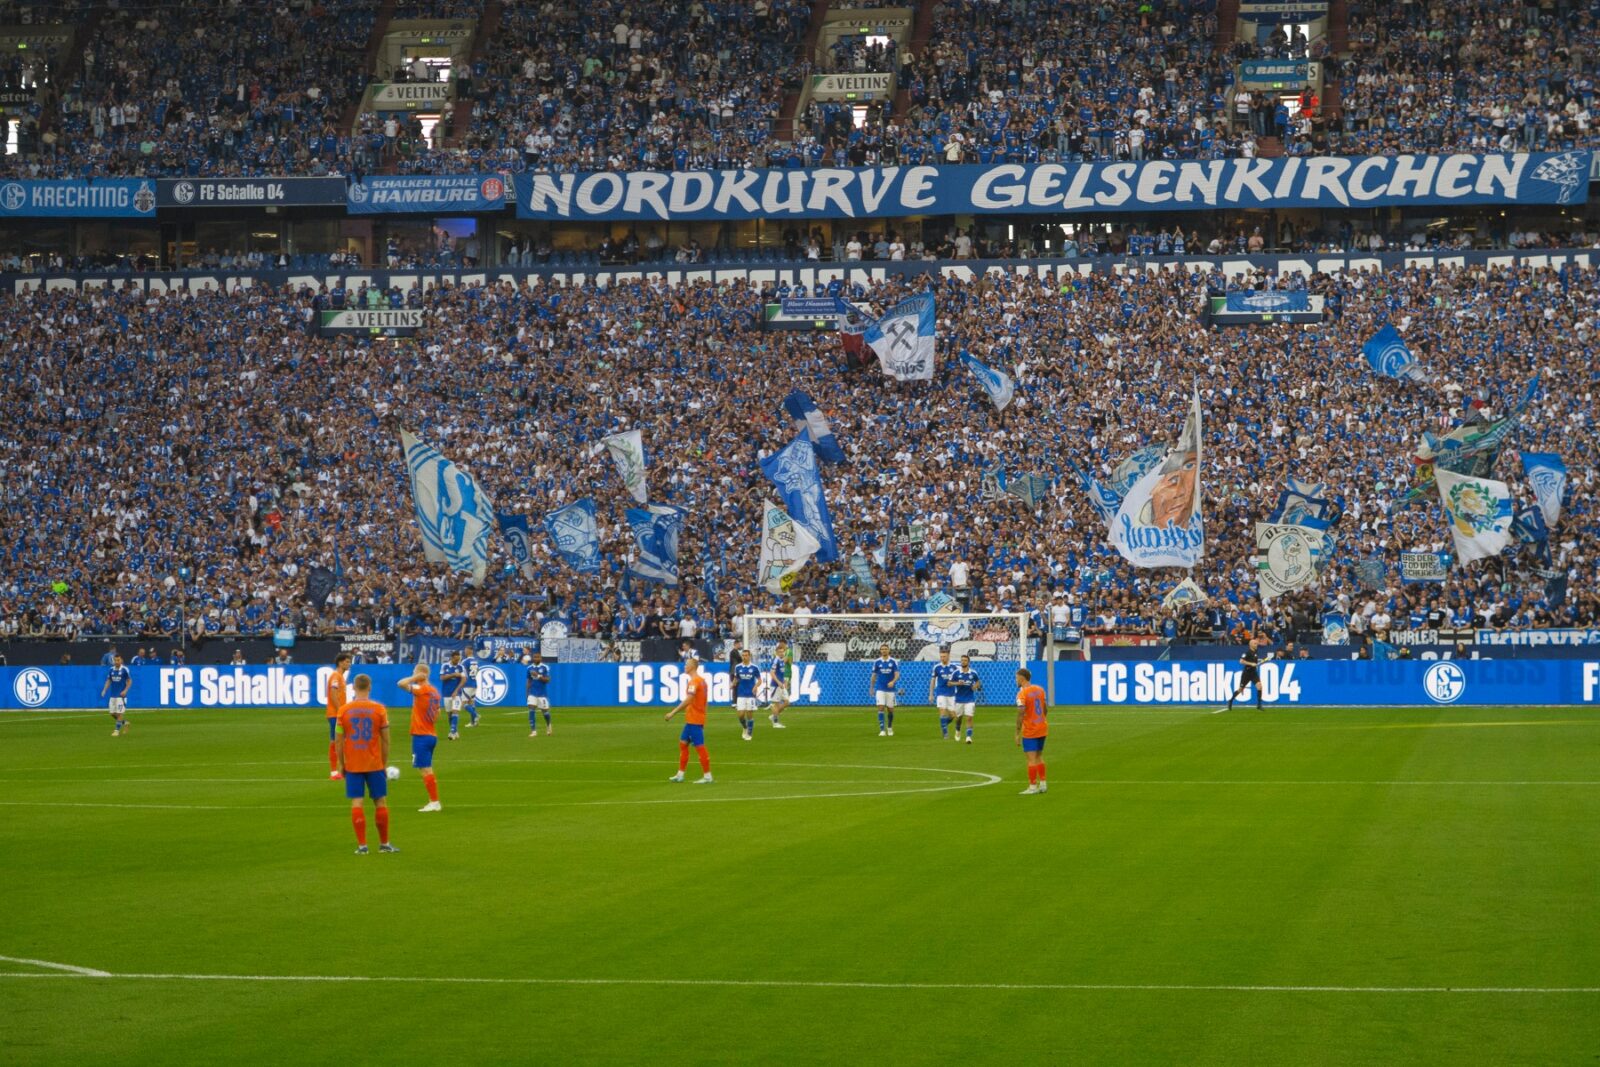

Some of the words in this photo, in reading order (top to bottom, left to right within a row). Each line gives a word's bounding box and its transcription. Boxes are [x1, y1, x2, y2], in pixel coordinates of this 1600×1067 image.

[850, 19, 905, 27] VELTINS
[836, 76, 889, 89] VELTINS
[396, 86, 449, 99] VELTINS
[200, 184, 214, 200] FC
[217, 184, 264, 200] Schalke
[267, 183, 285, 200] 04
[371, 178, 431, 189] SCHALKER
[434, 177, 479, 187] FILIALE
[529, 165, 939, 221] NORDKURVE
[970, 151, 1532, 209] GELSENKIRCHEN
[32, 186, 129, 207] KRECHTING
[371, 187, 478, 204] HAMBURG
[357, 312, 419, 326] VELTINS
[1389, 629, 1438, 645] MARLER
[160, 667, 193, 705] FC
[200, 666, 310, 705] Schalke
[618, 665, 657, 703] FC
[1092, 663, 1127, 702] FC
[1134, 663, 1252, 702] Schalke
[1260, 663, 1301, 702] 04
[349, 717, 373, 741] 38
